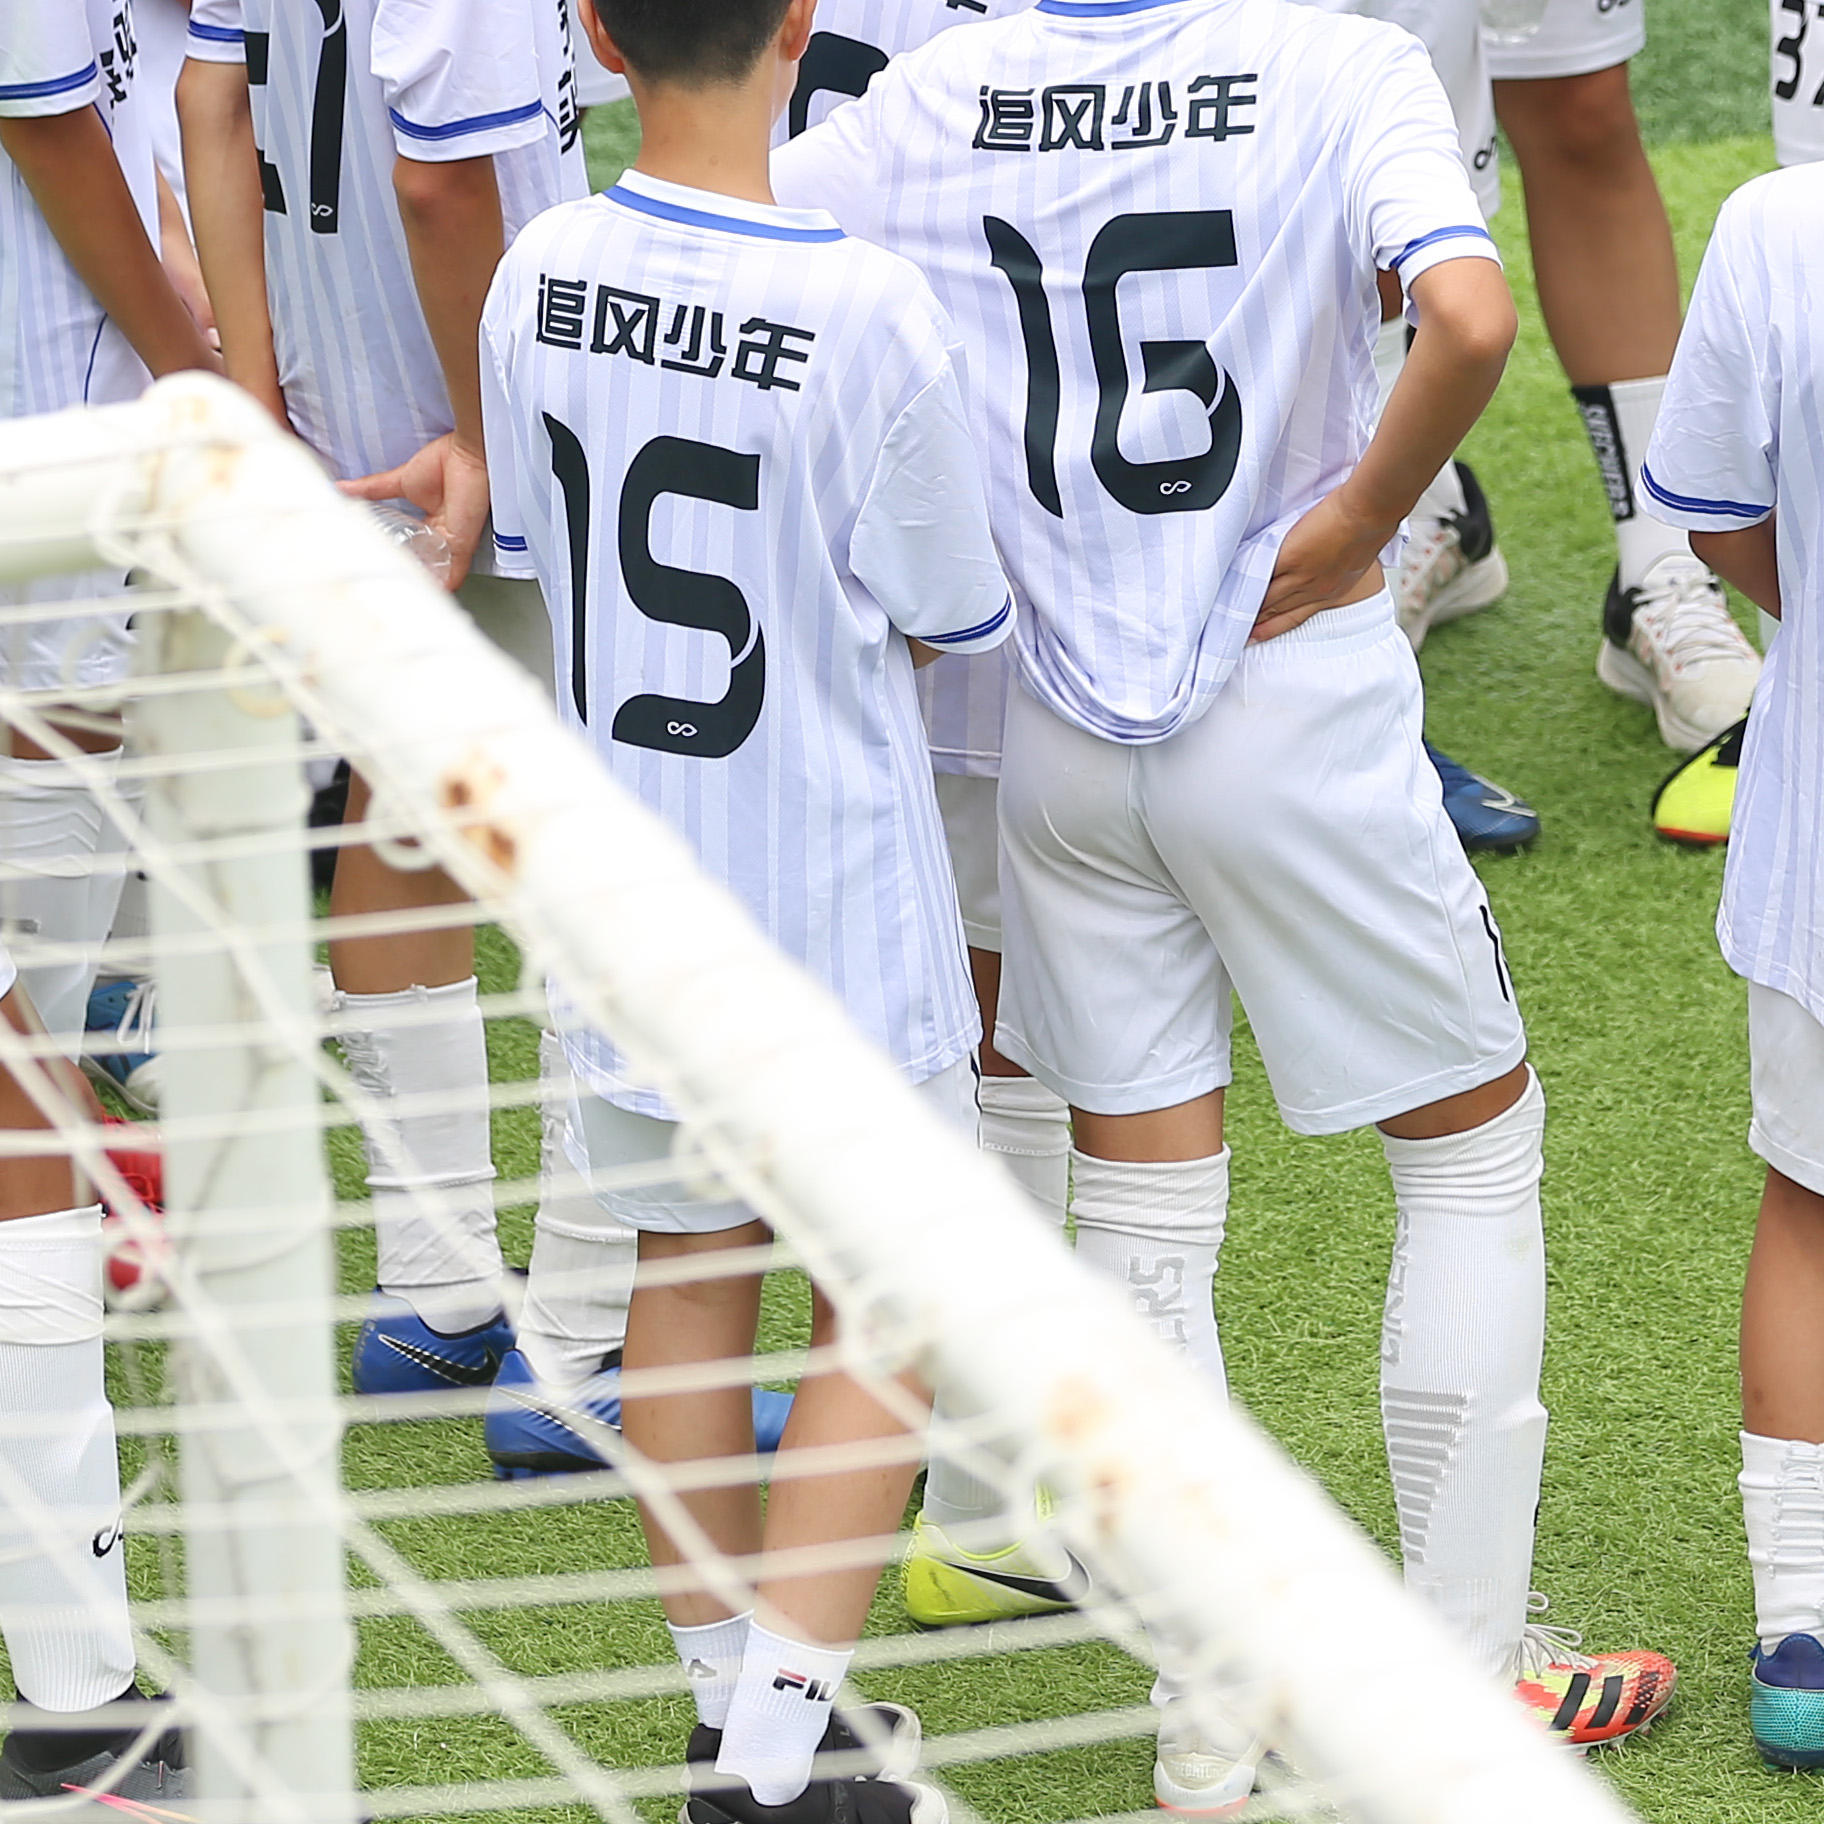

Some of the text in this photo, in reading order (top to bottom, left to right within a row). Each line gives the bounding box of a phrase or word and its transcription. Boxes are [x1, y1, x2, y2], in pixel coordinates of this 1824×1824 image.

[972, 73, 1259, 153] 追风少年
[535, 273, 815, 392] 追风少年
[982, 209, 1243, 519] 16
[542, 410, 765, 758] 15
[772, 1667, 843, 1702] FIL
